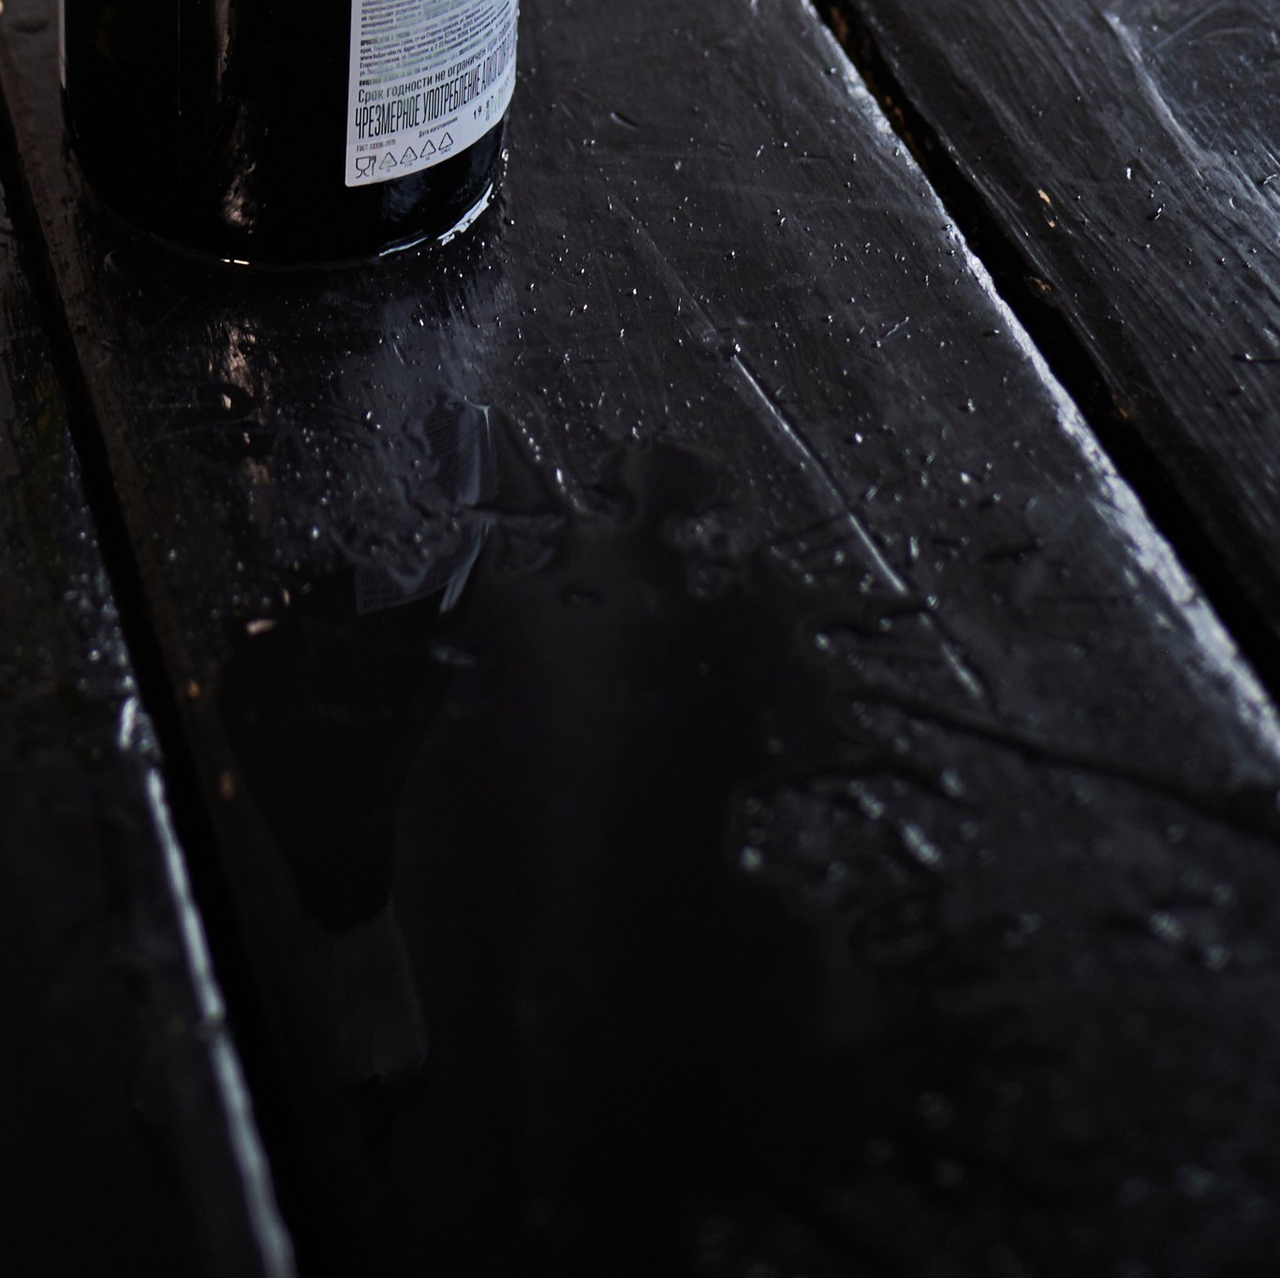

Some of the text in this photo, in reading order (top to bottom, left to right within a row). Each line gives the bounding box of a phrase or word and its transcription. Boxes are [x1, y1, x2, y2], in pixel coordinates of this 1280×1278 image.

[355, 93, 420, 139] ЧРЕЗМЕРНОЕ
[422, 63, 481, 124] УПОТРЕБЛЕНИЕ
[358, 88, 384, 105] Срок
[386, 76, 433, 98] годности
[435, 67, 446, 83] не
[447, 48, 486, 77] ограничен
